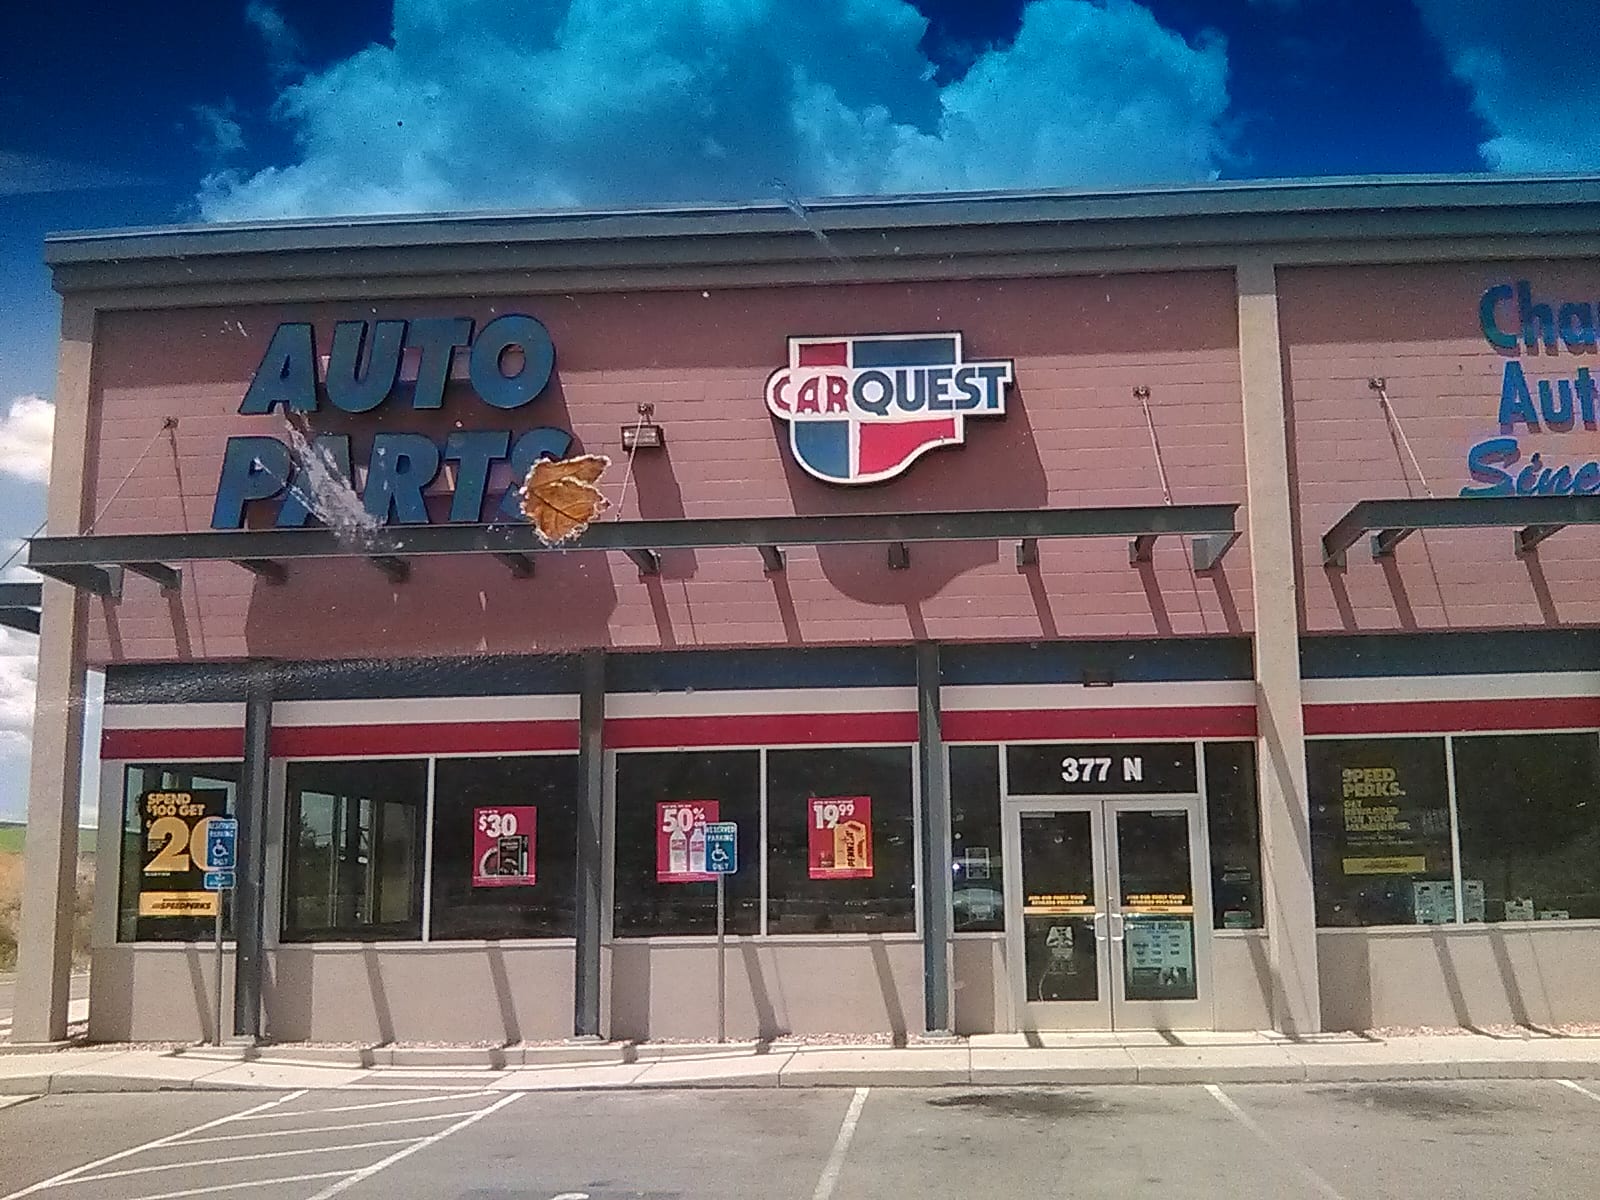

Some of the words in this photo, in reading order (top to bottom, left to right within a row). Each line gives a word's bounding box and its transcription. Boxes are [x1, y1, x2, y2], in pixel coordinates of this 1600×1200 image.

[238, 311, 557, 415] AUTO
[772, 367, 1007, 417] CARQUEST
[1061, 757, 1112, 782] 377
[1123, 757, 1143, 781] N
[1342, 767, 1396, 783] SPEED
[147, 792, 192, 805] SPEND
[178, 803, 206, 816] GET
[478, 813, 518, 838] $30
[707, 834, 734, 842] PARKING
[712, 862, 729, 870] ONLY
